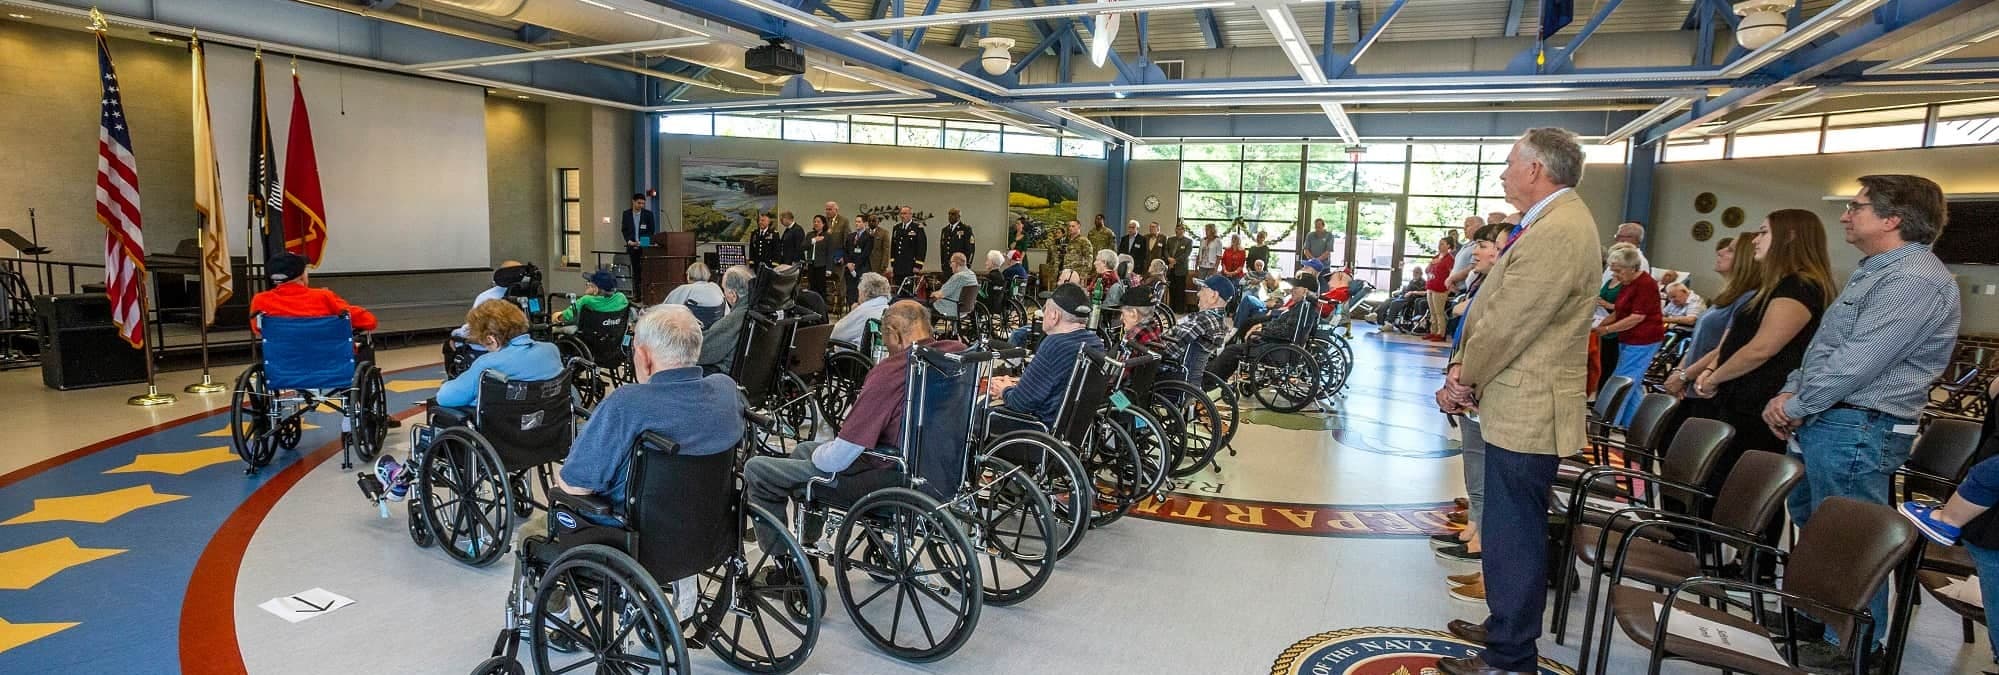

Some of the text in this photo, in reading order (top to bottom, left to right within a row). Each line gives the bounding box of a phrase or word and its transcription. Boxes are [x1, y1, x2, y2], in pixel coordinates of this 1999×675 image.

[1312, 639, 1433, 675] OF THE NAVY
